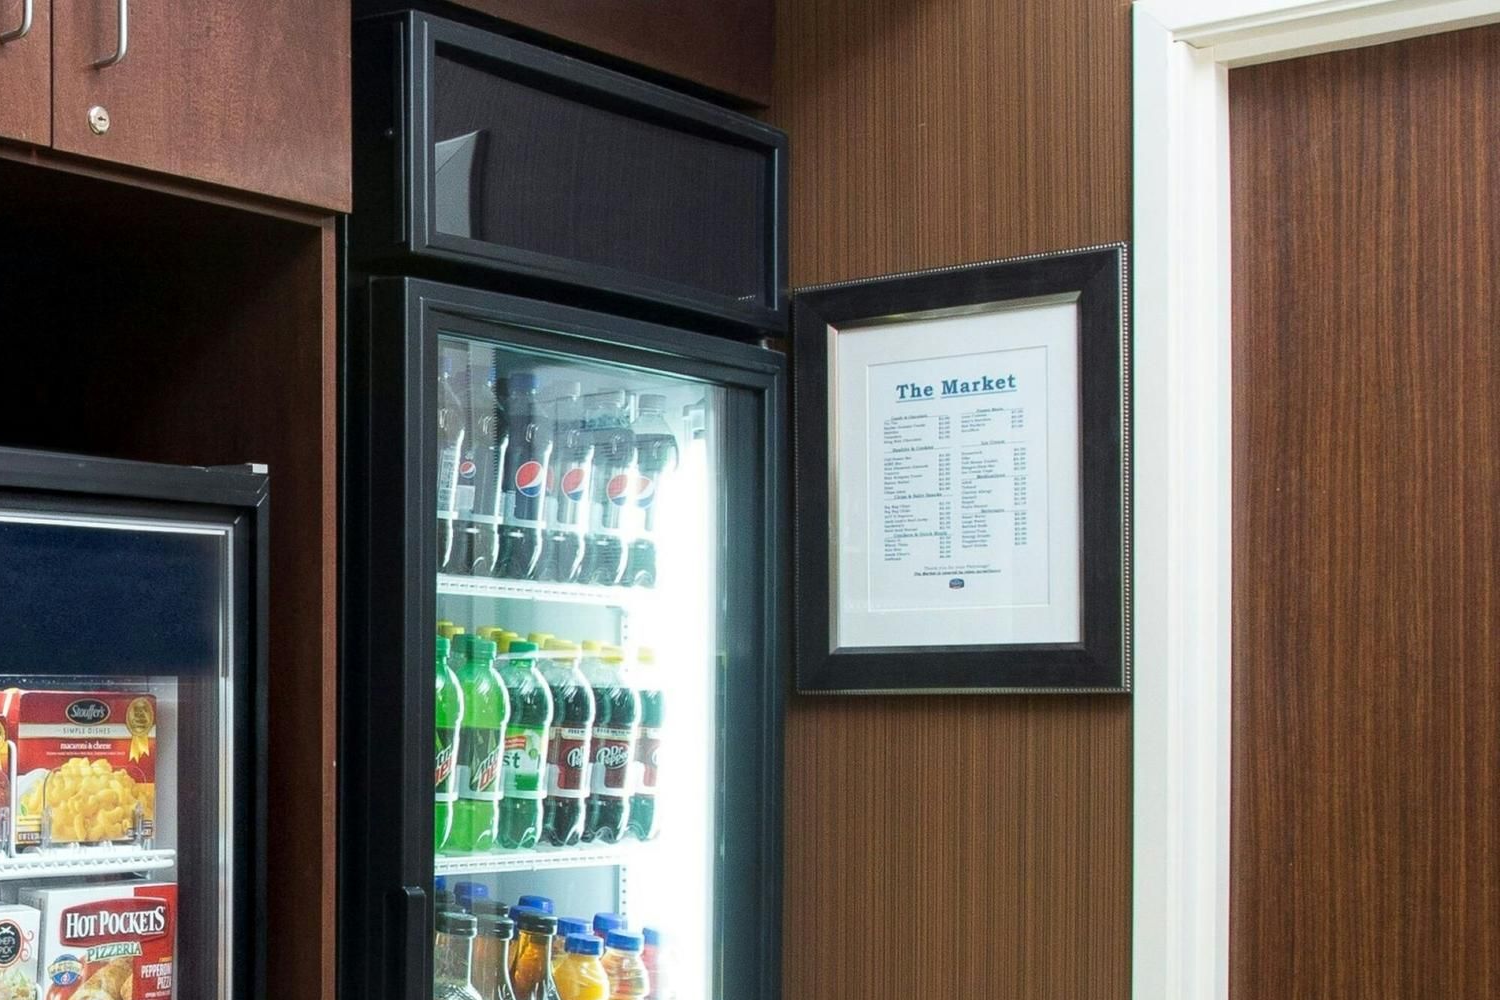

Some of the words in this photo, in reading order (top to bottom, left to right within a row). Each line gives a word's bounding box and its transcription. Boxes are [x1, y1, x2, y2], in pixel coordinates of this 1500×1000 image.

[896, 383, 934, 401] The
[940, 374, 1017, 397] Market
[71, 704, 106, 721] Stouffer's
[60, 741, 88, 750] macaroni
[92, 741, 112, 750] cheese
[65, 912, 98, 939] HOT
[99, 906, 165, 936] POCKETS
[87, 942, 142, 961] PIZZERIA
